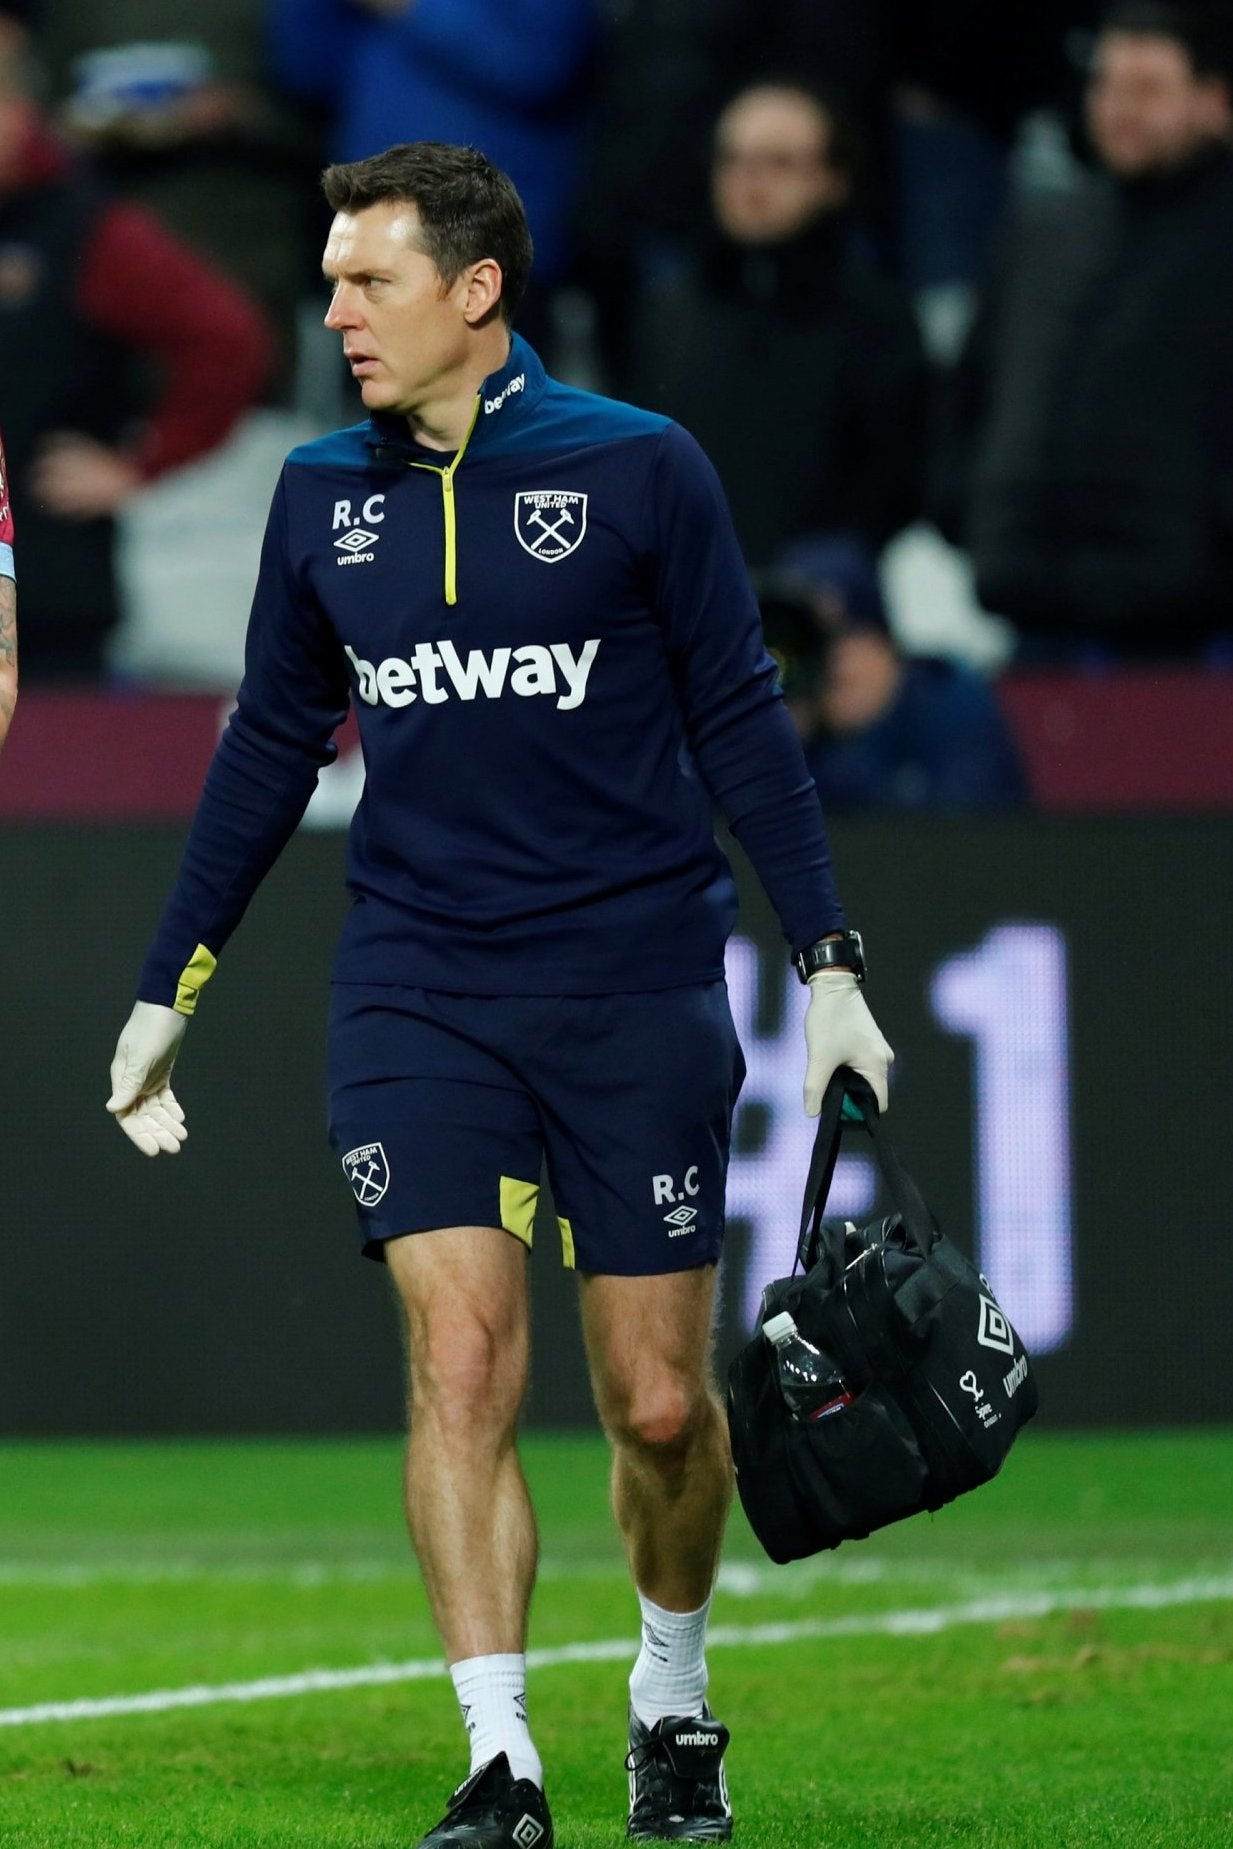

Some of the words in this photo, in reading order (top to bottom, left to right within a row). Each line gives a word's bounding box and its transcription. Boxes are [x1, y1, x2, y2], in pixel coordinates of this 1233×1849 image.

[524, 494, 552, 504] WEST
[553, 494, 579, 505] HAM
[535, 501, 567, 509] UNITED
[332, 493, 386, 530] R.C
[538, 547, 564, 556] LONDON
[337, 552, 375, 566] umbro
[344, 638, 601, 711] betway
[652, 1165, 700, 1206] R.C
[668, 1225, 696, 1238] umbro
[675, 1730, 719, 1746] umbro
